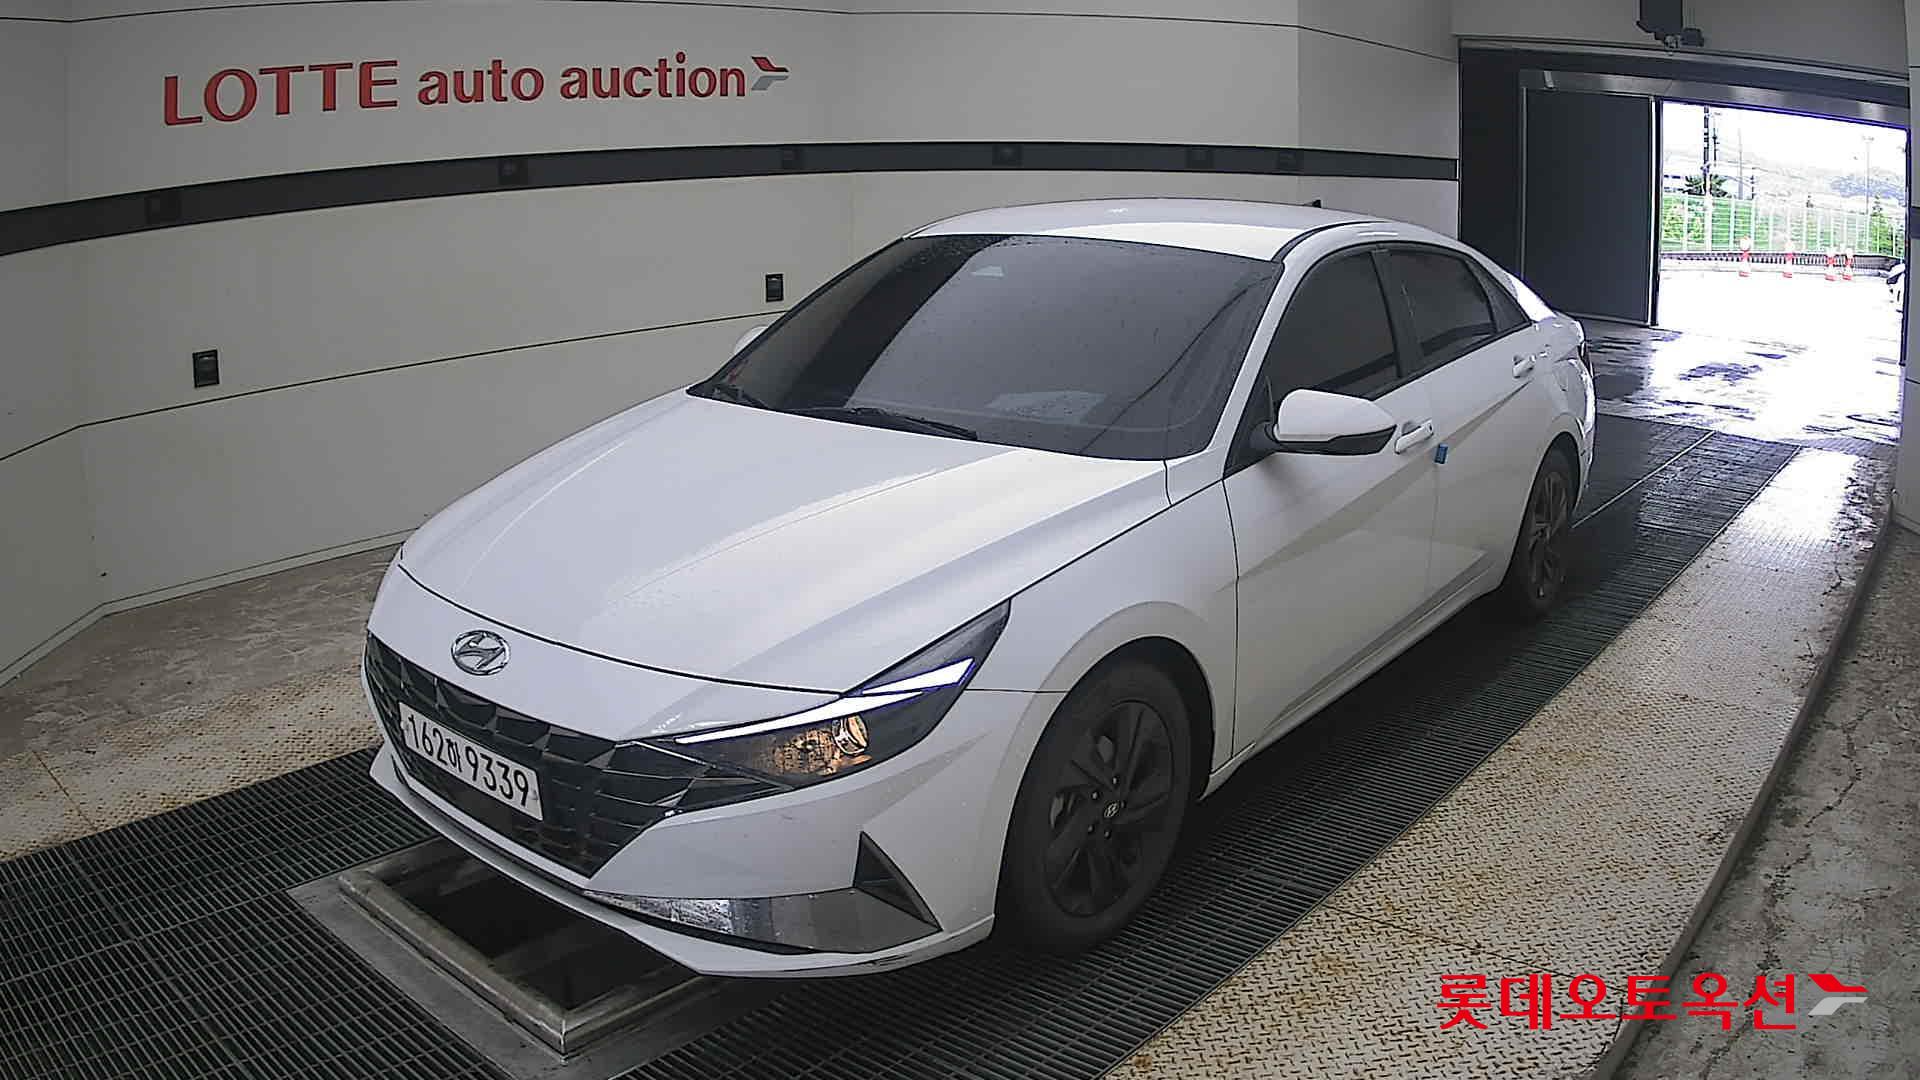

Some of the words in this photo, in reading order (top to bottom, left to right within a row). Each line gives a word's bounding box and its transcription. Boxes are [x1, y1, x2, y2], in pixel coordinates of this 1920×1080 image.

[164, 60, 400, 126] LOTTE
[417, 58, 545, 106] auto
[560, 51, 747, 99] auction
[465, 745, 529, 807] 9339
